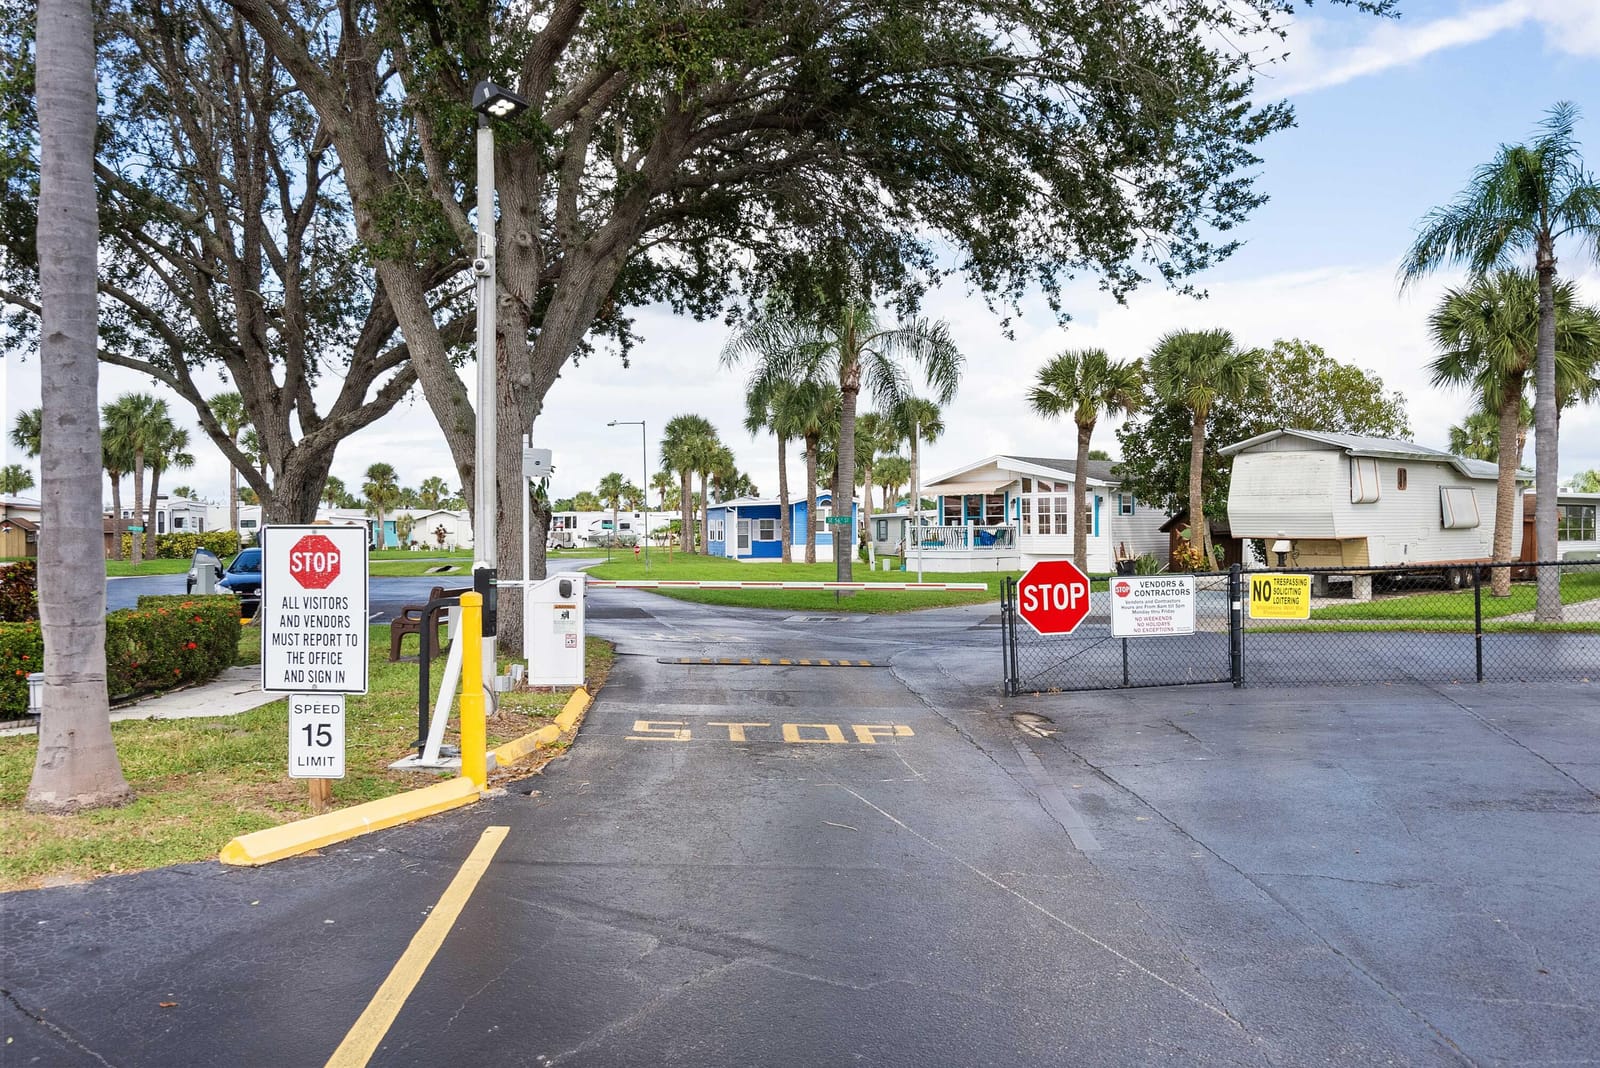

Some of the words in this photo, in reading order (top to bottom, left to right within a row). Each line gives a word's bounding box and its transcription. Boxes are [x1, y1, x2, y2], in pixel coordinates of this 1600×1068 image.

[291, 552, 339, 573] STOP
[1274, 578, 1308, 586] TRESPASSING
[1023, 582, 1085, 612] STOP
[1134, 588, 1190, 597] CONTRACTORS
[1253, 580, 1272, 602] NO
[282, 596, 300, 610] ALL
[303, 596, 348, 610] VISITORS
[1273, 596, 1300, 604] LOITERING
[280, 614, 300, 628] AND
[303, 614, 350, 628] VENDORS
[272, 633, 300, 646] MUST
[303, 633, 342, 646] REPORT
[345, 633, 358, 646] TO
[286, 652, 305, 665] THE
[308, 652, 342, 665] OFFICE
[284, 670, 304, 683] AND
[308, 670, 332, 683] SIGN
[335, 670, 346, 683] IN
[294, 704, 340, 714] SPEED
[302, 723, 332, 747] 15
[624, 720, 915, 744] STOP
[298, 756, 335, 767] LIMIT
